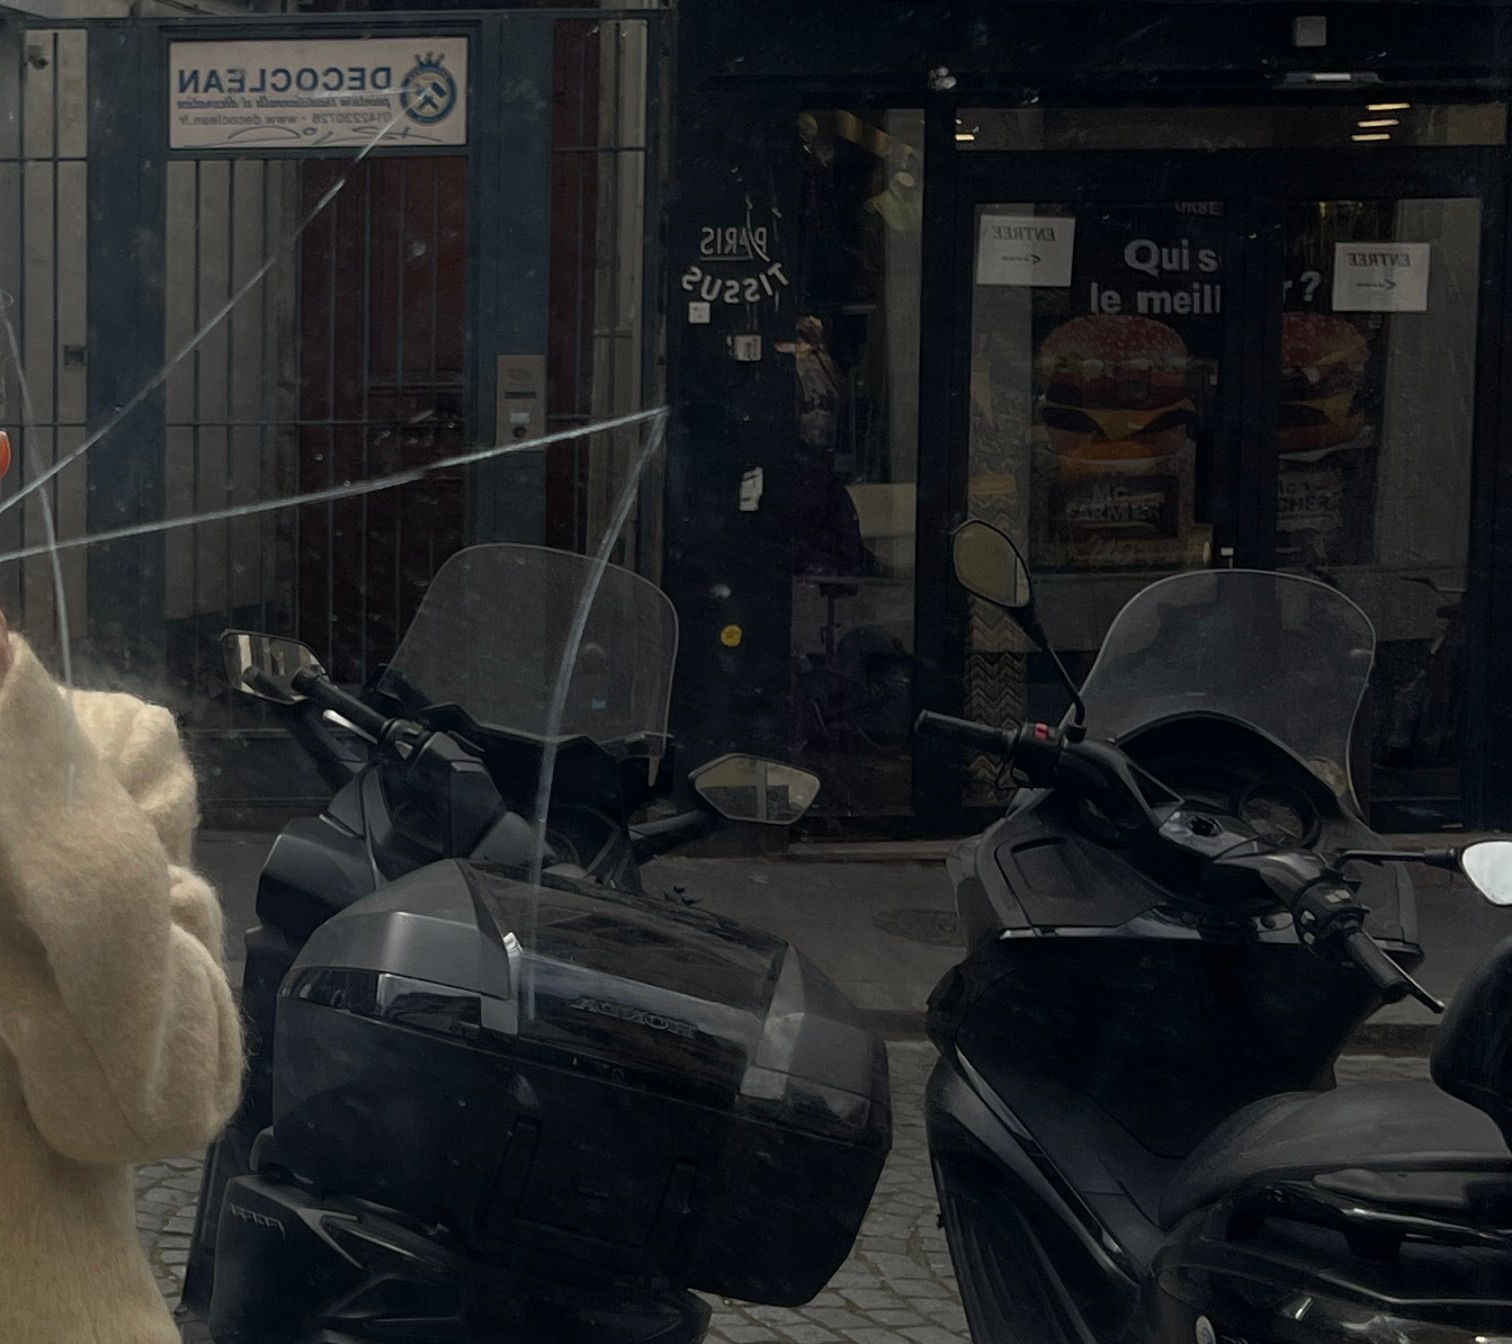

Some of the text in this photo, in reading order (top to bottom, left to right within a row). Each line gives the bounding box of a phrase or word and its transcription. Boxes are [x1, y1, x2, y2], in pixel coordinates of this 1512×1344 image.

[1123, 239, 1223, 278] Qui s
[1090, 281, 1123, 314] le
